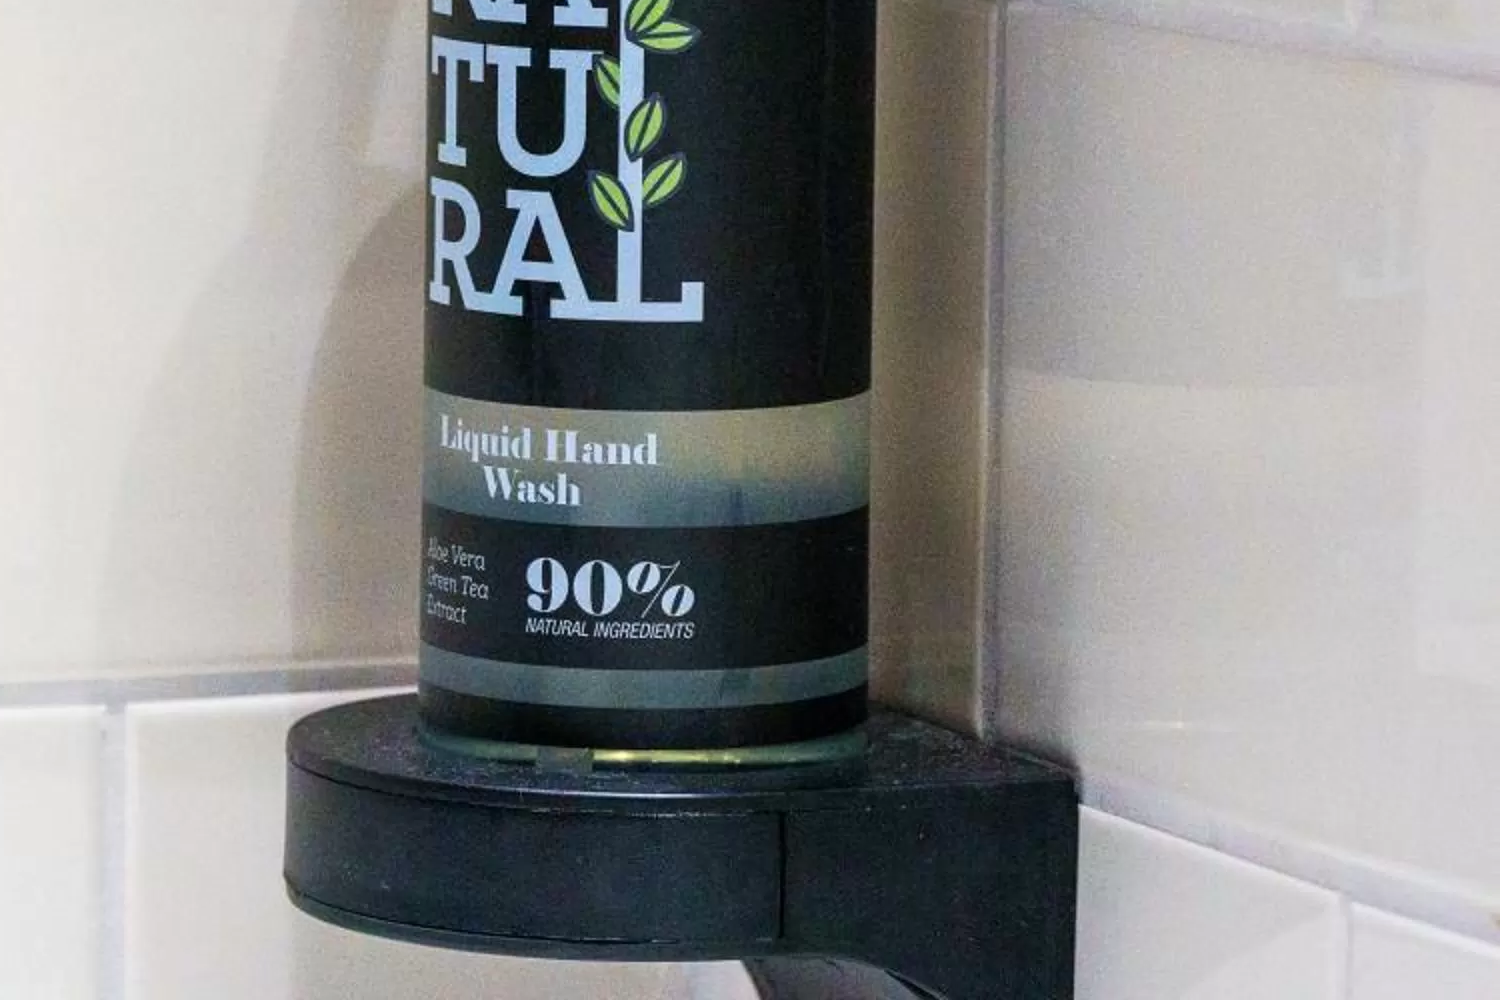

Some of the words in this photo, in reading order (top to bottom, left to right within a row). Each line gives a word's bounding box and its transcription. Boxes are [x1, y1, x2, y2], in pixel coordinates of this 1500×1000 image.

[440, 415, 532, 462] Liquid
[544, 429, 659, 466] Hand
[483, 465, 582, 506] Wash
[451, 544, 486, 572] Vera
[461, 575, 489, 601] Tea
[526, 557, 695, 618] 90%
[525, 617, 589, 637] NATURAL
[593, 621, 695, 640] INGREDIENTS
